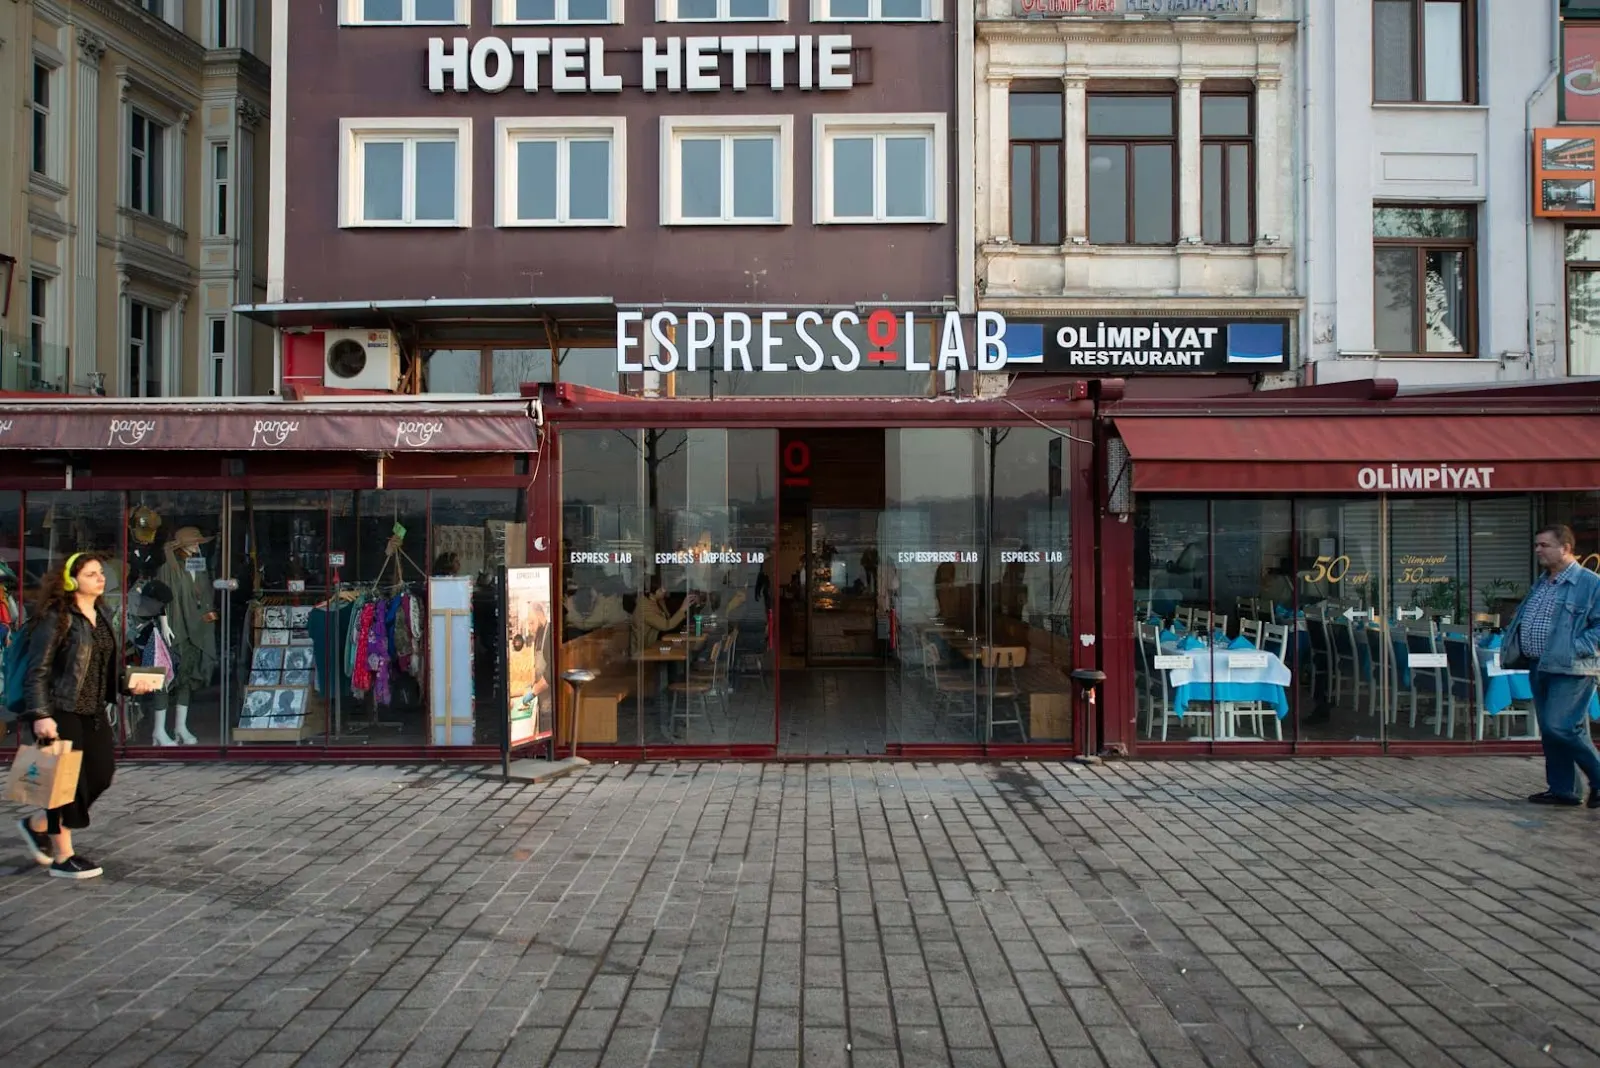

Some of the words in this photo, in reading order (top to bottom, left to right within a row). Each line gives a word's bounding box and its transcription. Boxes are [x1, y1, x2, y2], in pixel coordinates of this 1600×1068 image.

[428, 36, 622, 93] HOTEL
[642, 35, 853, 92] HETTIE
[616, 309, 1008, 373] ESPRESSOLAB
[1056, 322, 1219, 349] OLİMPİYAT
[1070, 351, 1204, 366] RESTAURANT
[107, 418, 156, 446] pangu
[251, 419, 300, 447] pangu
[394, 420, 443, 447] pangu
[1357, 463, 1495, 490] OLİMPİYAT
